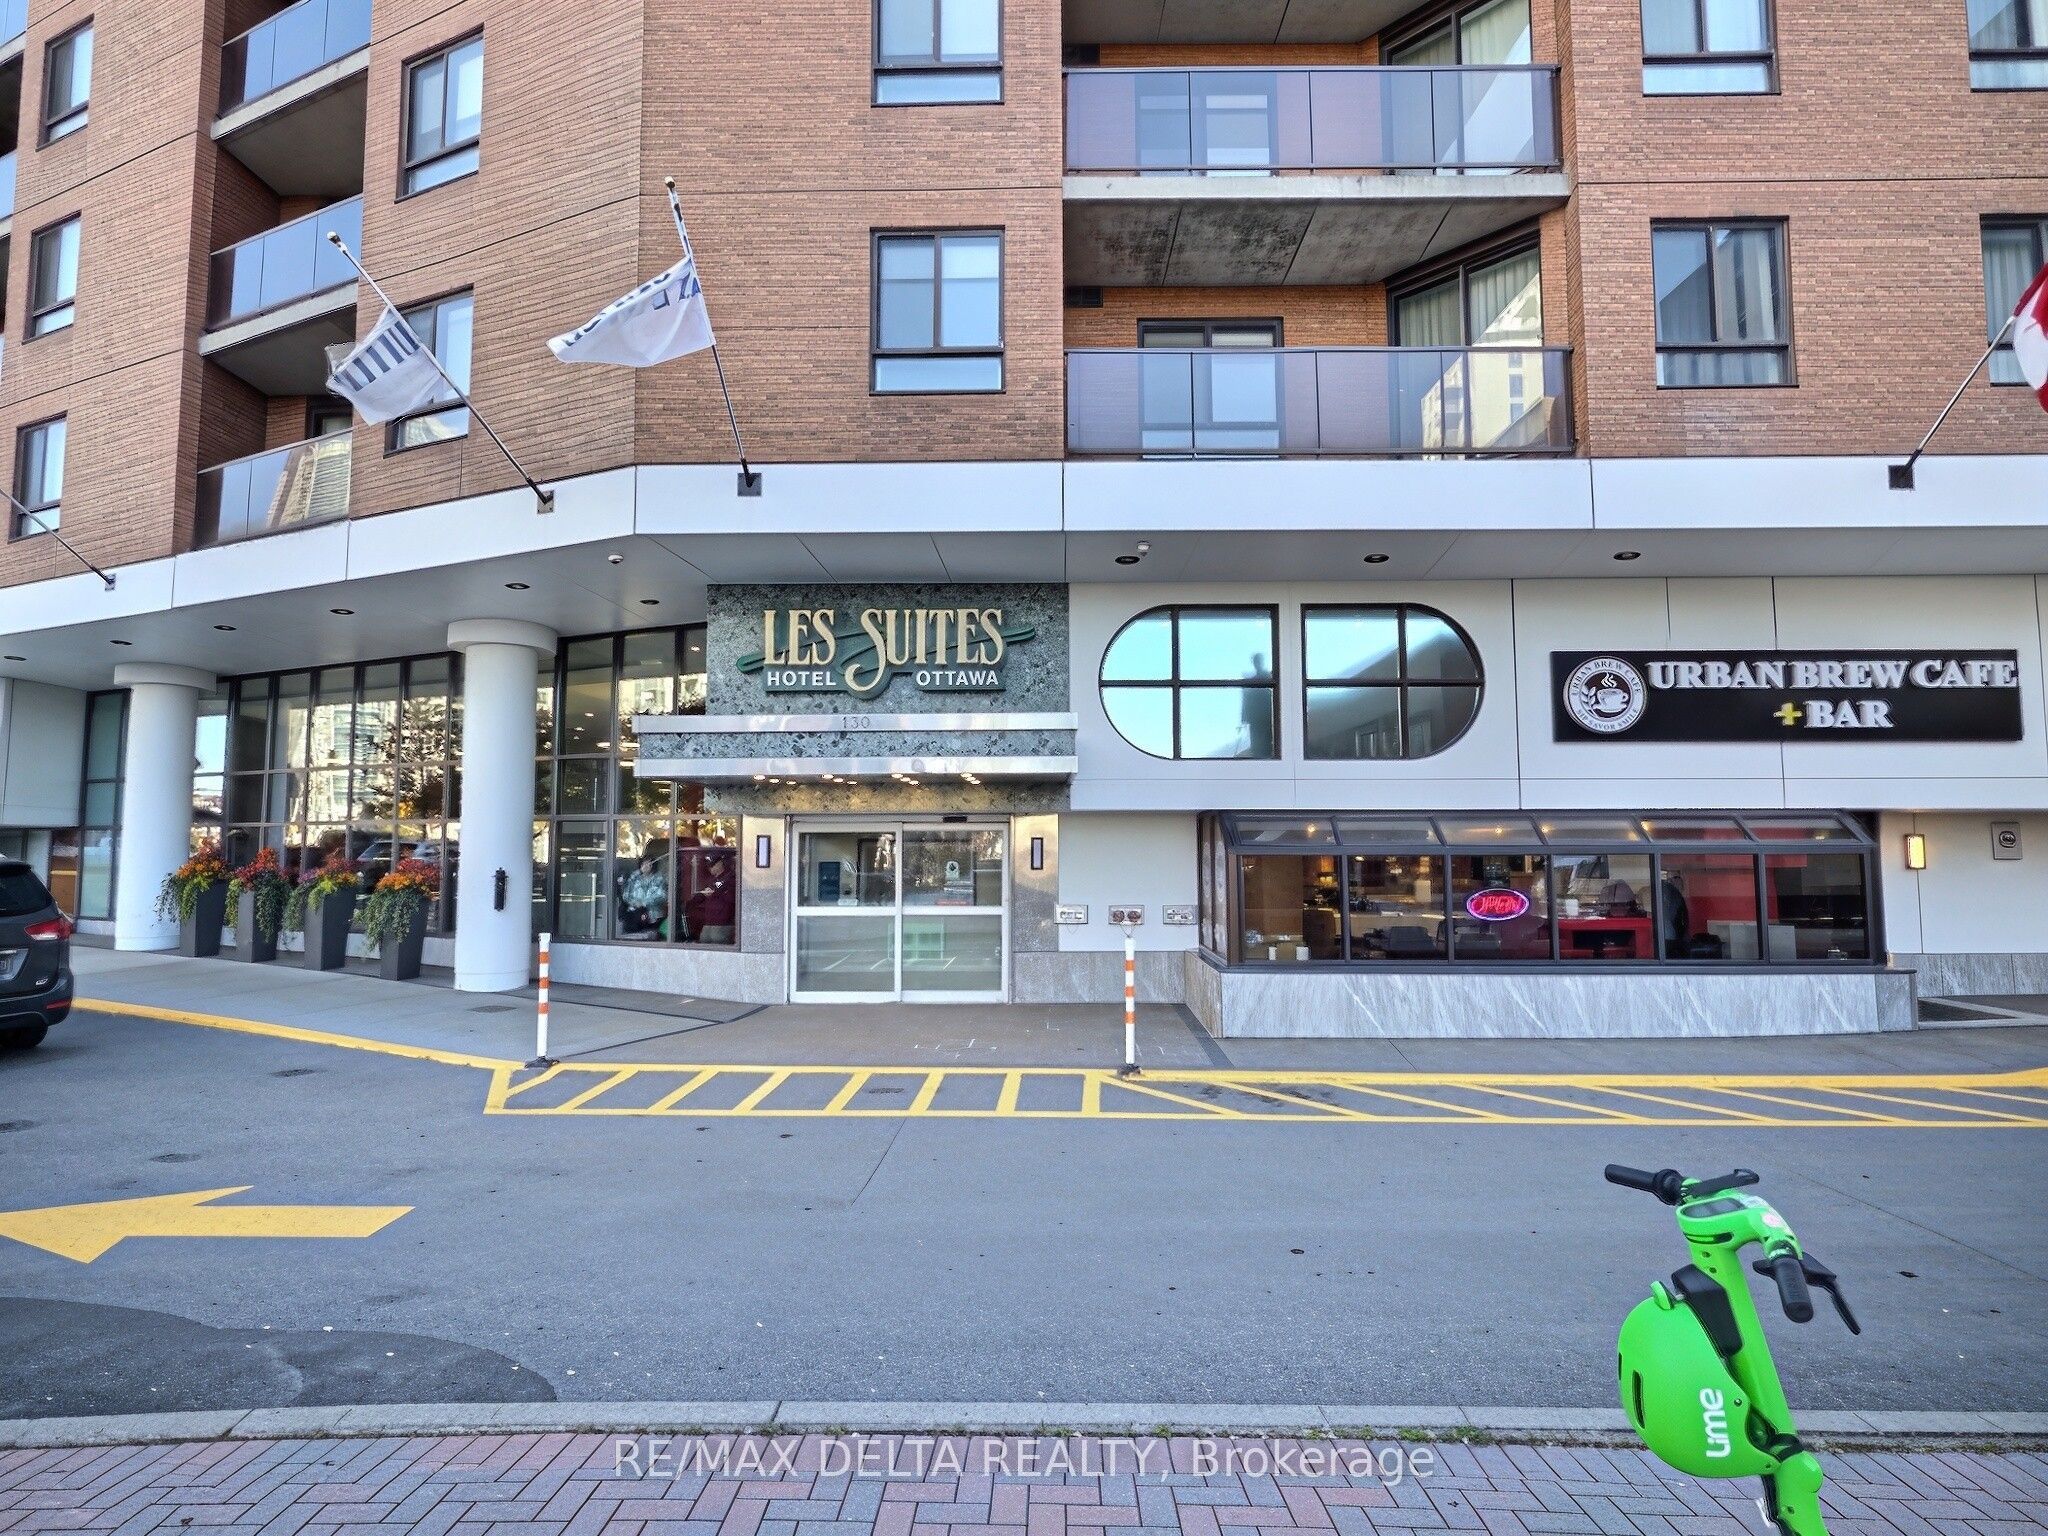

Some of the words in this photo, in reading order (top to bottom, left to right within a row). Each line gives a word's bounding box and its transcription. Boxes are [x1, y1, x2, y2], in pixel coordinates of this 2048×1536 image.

[763, 609, 836, 666] LES
[844, 608, 1004, 692] SUITES
[767, 671, 837, 686] HOTEL
[916, 670, 999, 686] OTTAWA
[1570, 665, 1592, 695] URBAN
[1594, 660, 1622, 670] BREW
[1645, 661, 1787, 689] URBAN
[1788, 660, 1911, 688] BREW
[1909, 660, 2018, 688] CAFE
[842, 716, 870, 729] 130
[1803, 700, 1895, 728] BAR
